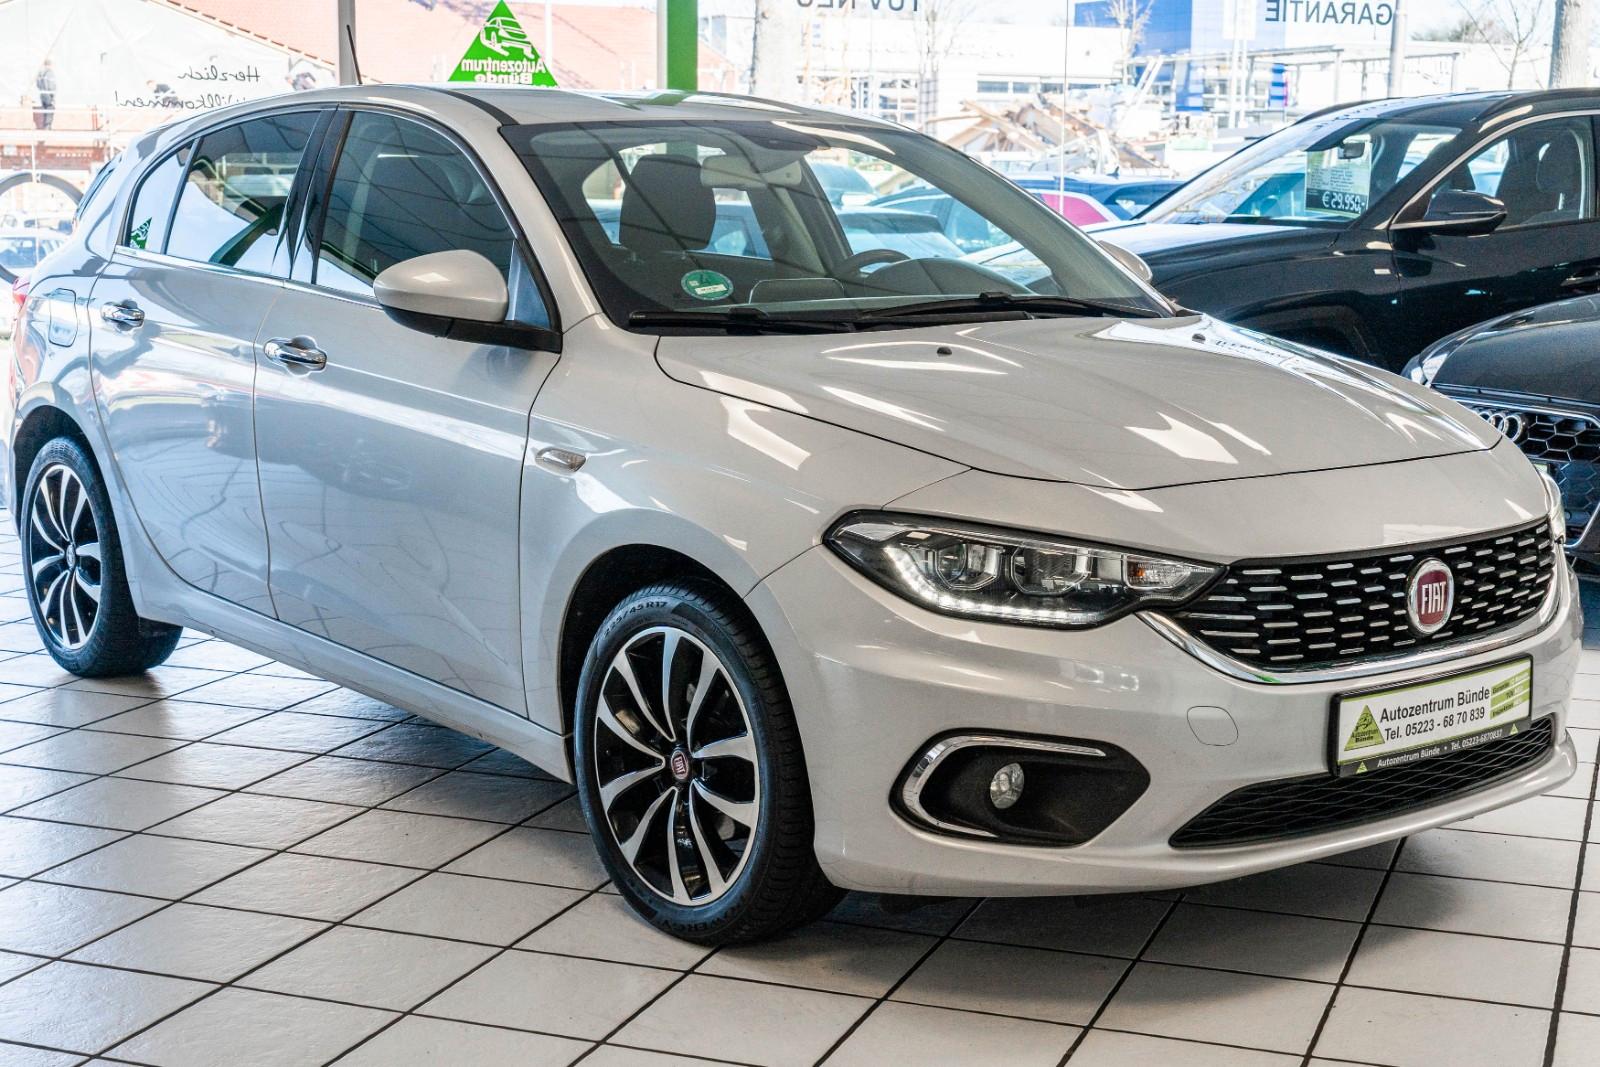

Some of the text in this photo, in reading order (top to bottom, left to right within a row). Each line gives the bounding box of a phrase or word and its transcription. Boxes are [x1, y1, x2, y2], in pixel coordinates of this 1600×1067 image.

[1421, 581, 1447, 615] FIAT
[1380, 685, 1490, 722] Autozentrum Bünde
[1384, 726, 1403, 742] Tel.
[1405, 715, 1435, 738] 05223
[1443, 711, 1454, 727] 68
[1456, 709, 1468, 726] 70
[1469, 706, 1486, 723] 839
[1377, 751, 1420, 768] Autozentrum
[1420, 745, 1441, 759] Bünde
[1450, 740, 1462, 751] Tel.
